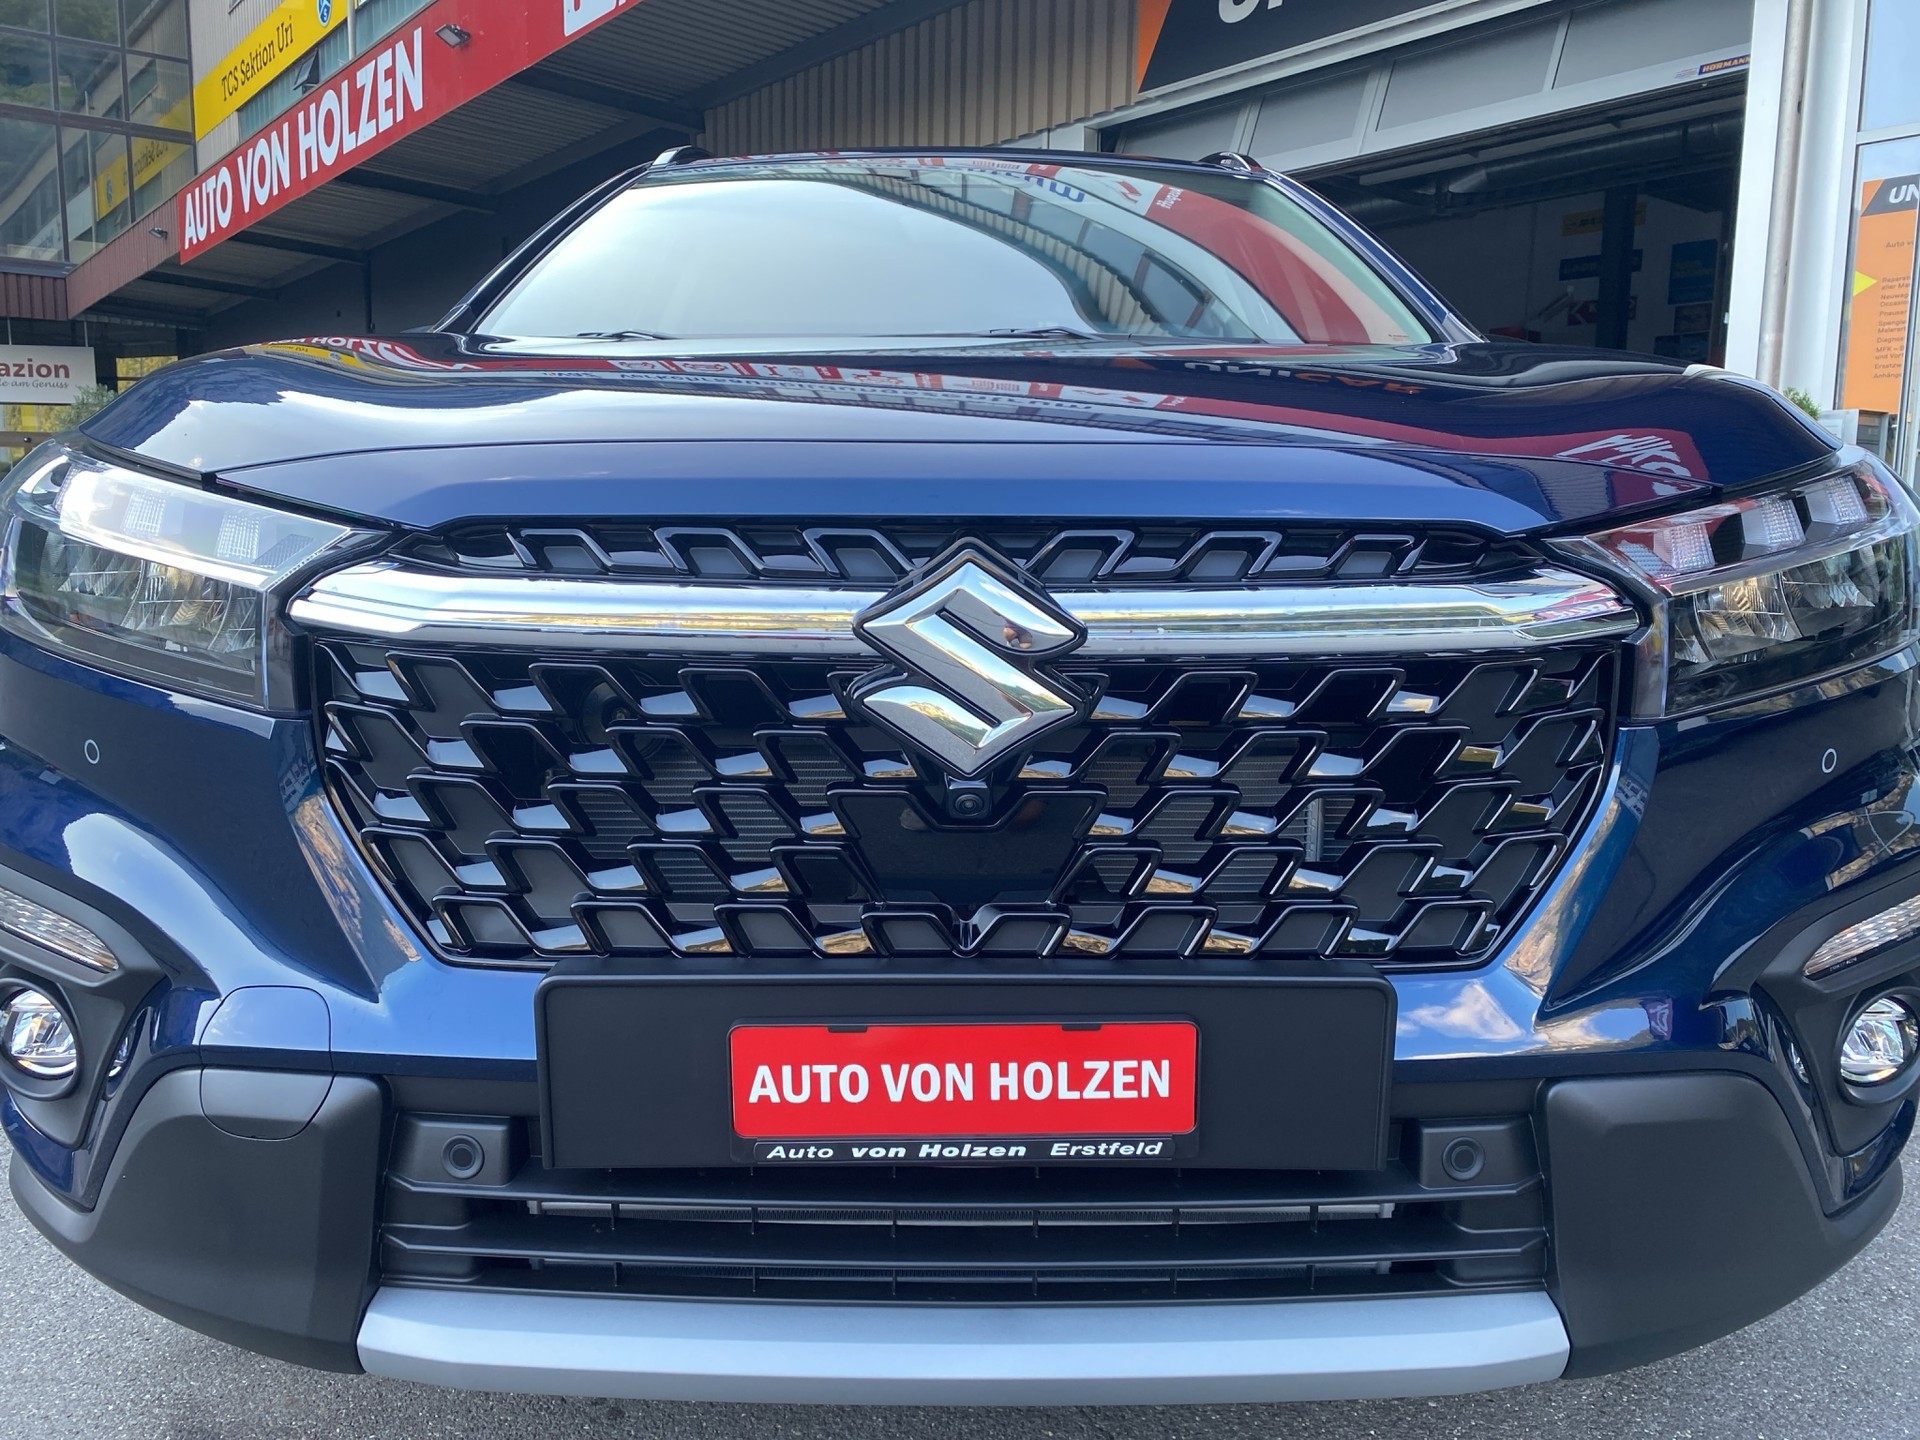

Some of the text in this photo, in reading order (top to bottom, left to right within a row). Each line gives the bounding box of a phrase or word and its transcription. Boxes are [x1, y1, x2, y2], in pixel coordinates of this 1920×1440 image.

[221, 14, 294, 102] TCS Sektion Uri
[184, 166, 233, 250] AUTO
[237, 121, 290, 213] VON
[297, 26, 424, 181] HOLZEN
[11, 380, 30, 388] am
[32, 379, 70, 389] Genuss
[748, 1059, 1170, 1104] AUTO VON HOLZEN
[766, 1141, 1164, 1159] Auto von Holzen Erstfeld
